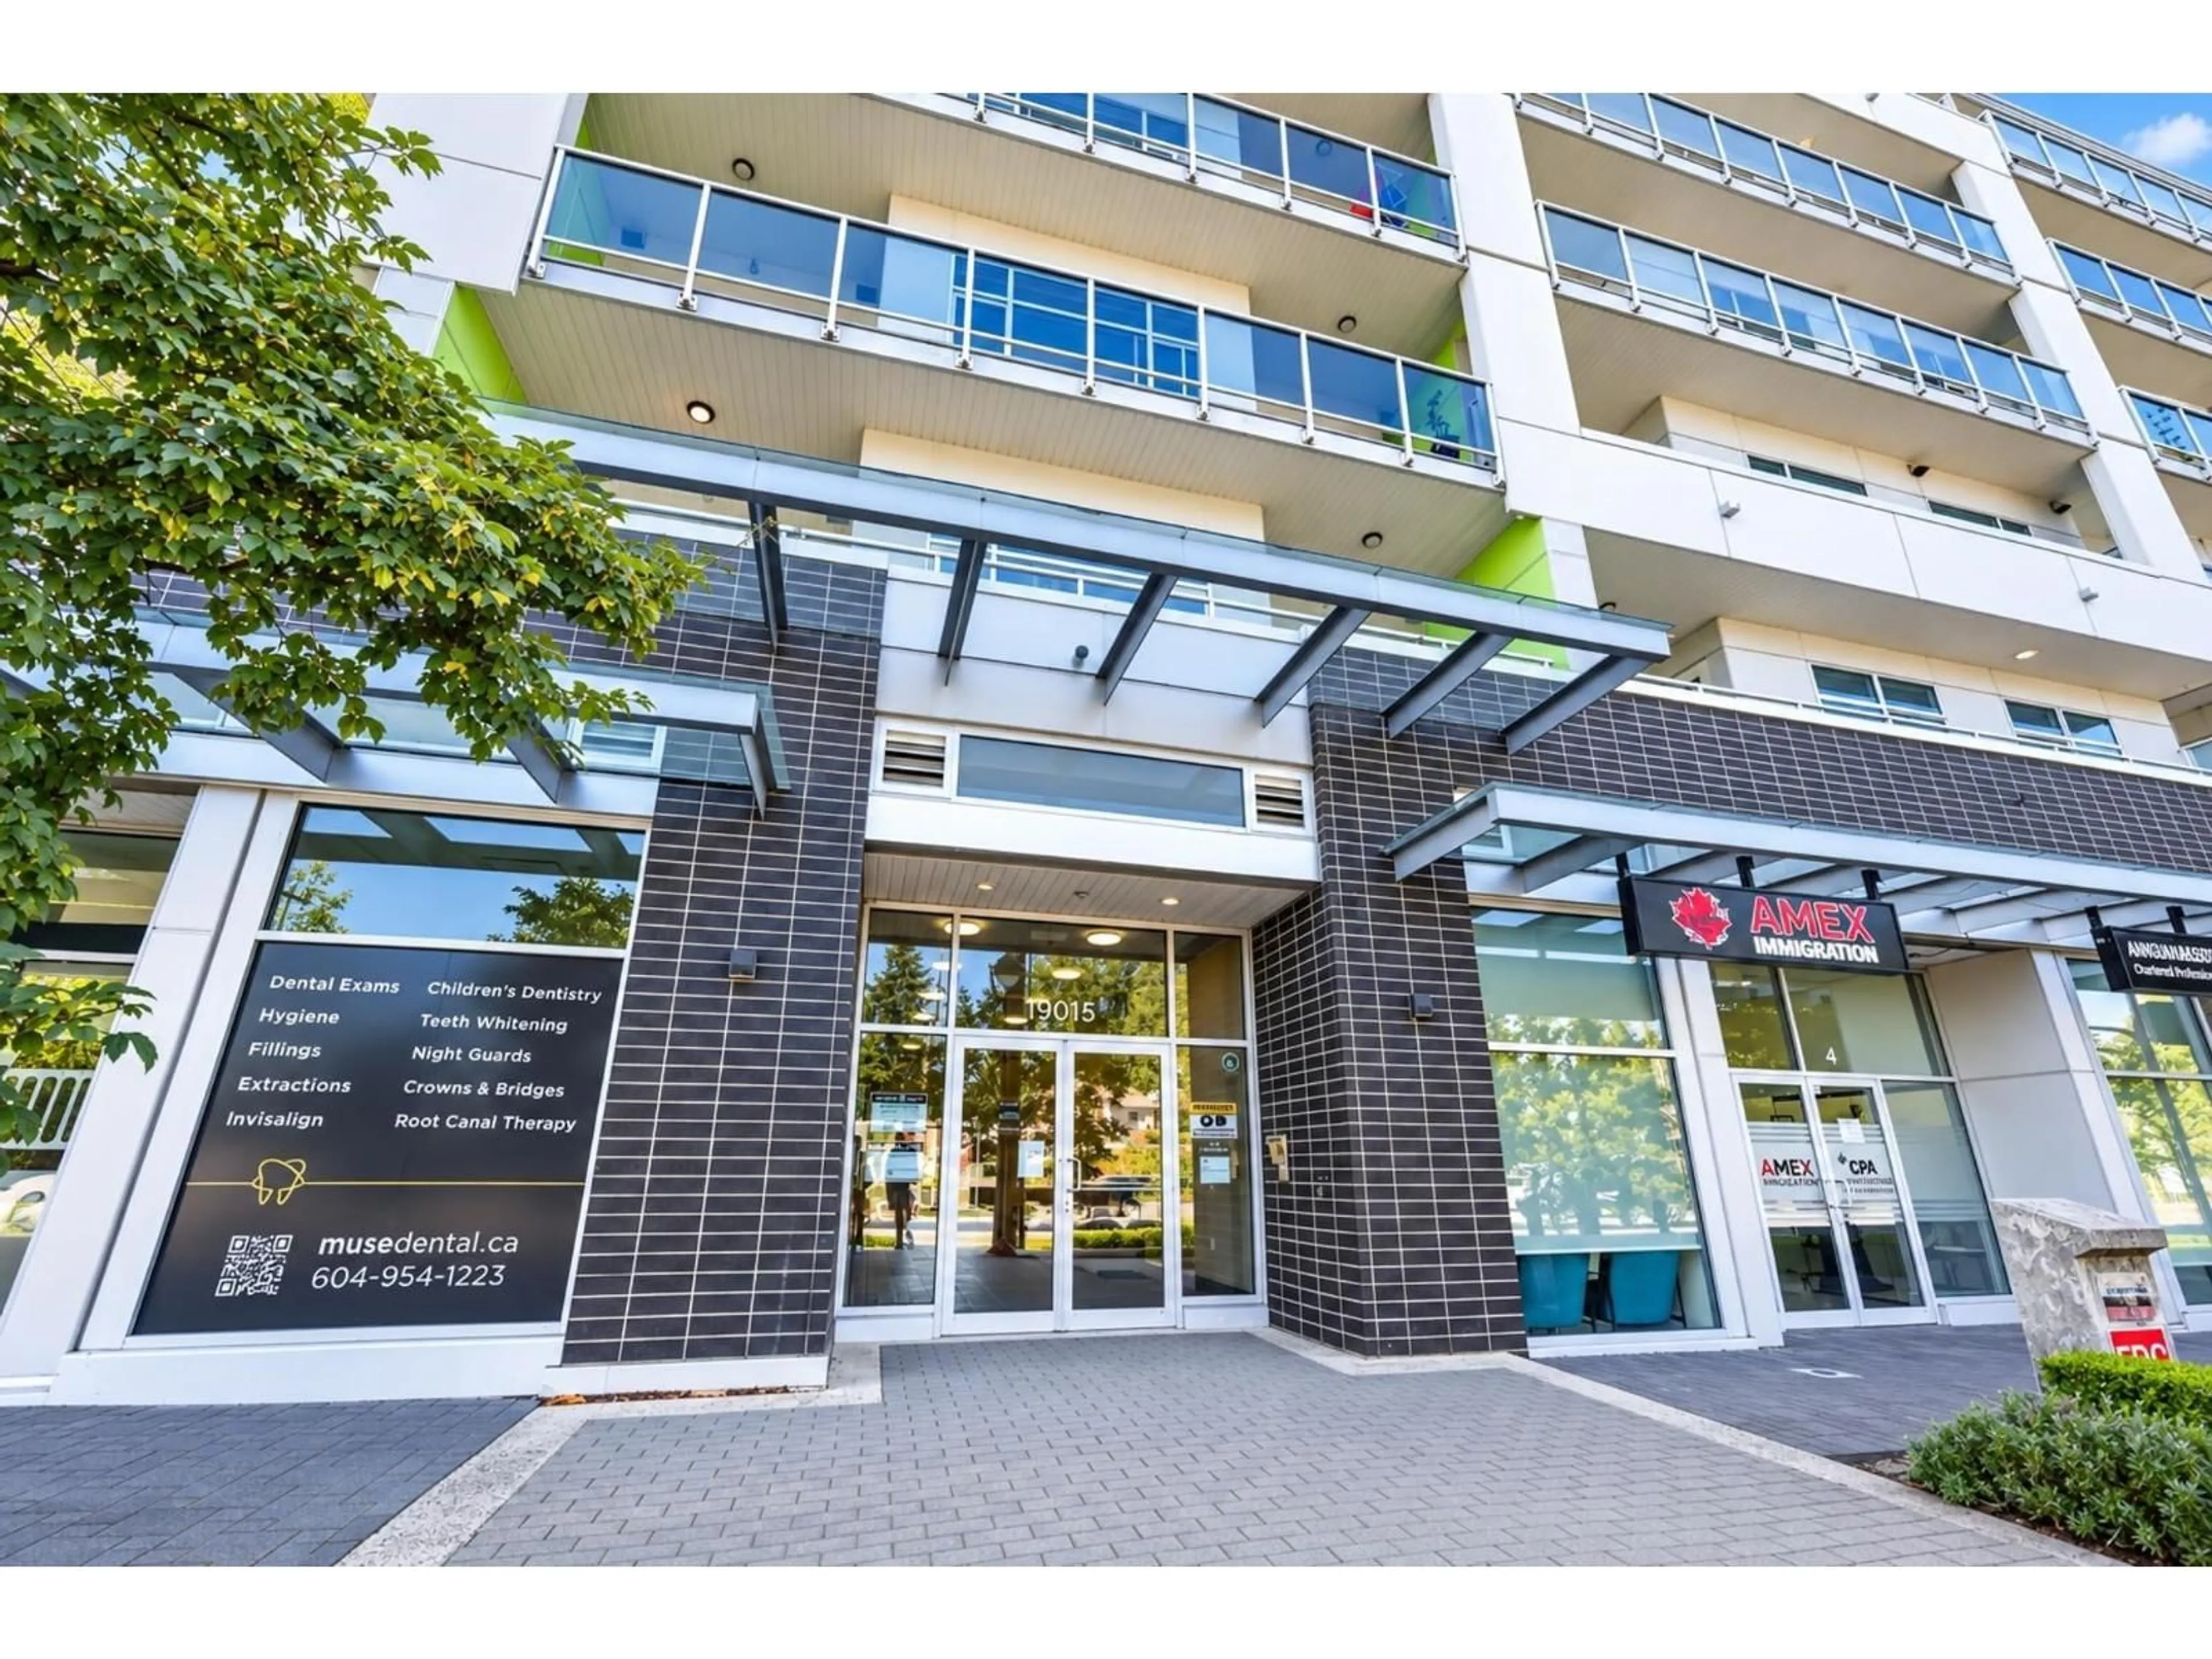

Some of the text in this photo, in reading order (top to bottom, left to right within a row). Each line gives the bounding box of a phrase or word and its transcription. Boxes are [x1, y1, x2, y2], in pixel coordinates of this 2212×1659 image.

[1750, 896, 1874, 943] AMEX
[1753, 937, 1880, 963] IMMIGRATION
[270, 975, 400, 994] Dental Exams
[427, 981, 601, 1004] Children's Dentistry
[259, 1007, 340, 1026] Hygiene
[1025, 998, 1096, 1022] 19015
[421, 1013, 567, 1035] Teeth Whitening
[248, 1041, 321, 1060] Fillings
[412, 1046, 531, 1063] Night Guards
[1825, 1047, 1837, 1065] 4
[237, 1076, 351, 1093] Extractions
[404, 1080, 564, 1100] Crowns & Bridges
[226, 1111, 323, 1130] Invisalign
[395, 1114, 577, 1133] Root Canal Therapy
[1762, 1158, 1815, 1177] AMEX
[1849, 1160, 1878, 1175] CPA
[319, 1231, 518, 1255] musedental.ca
[312, 1264, 506, 1289] 604-954-1223
